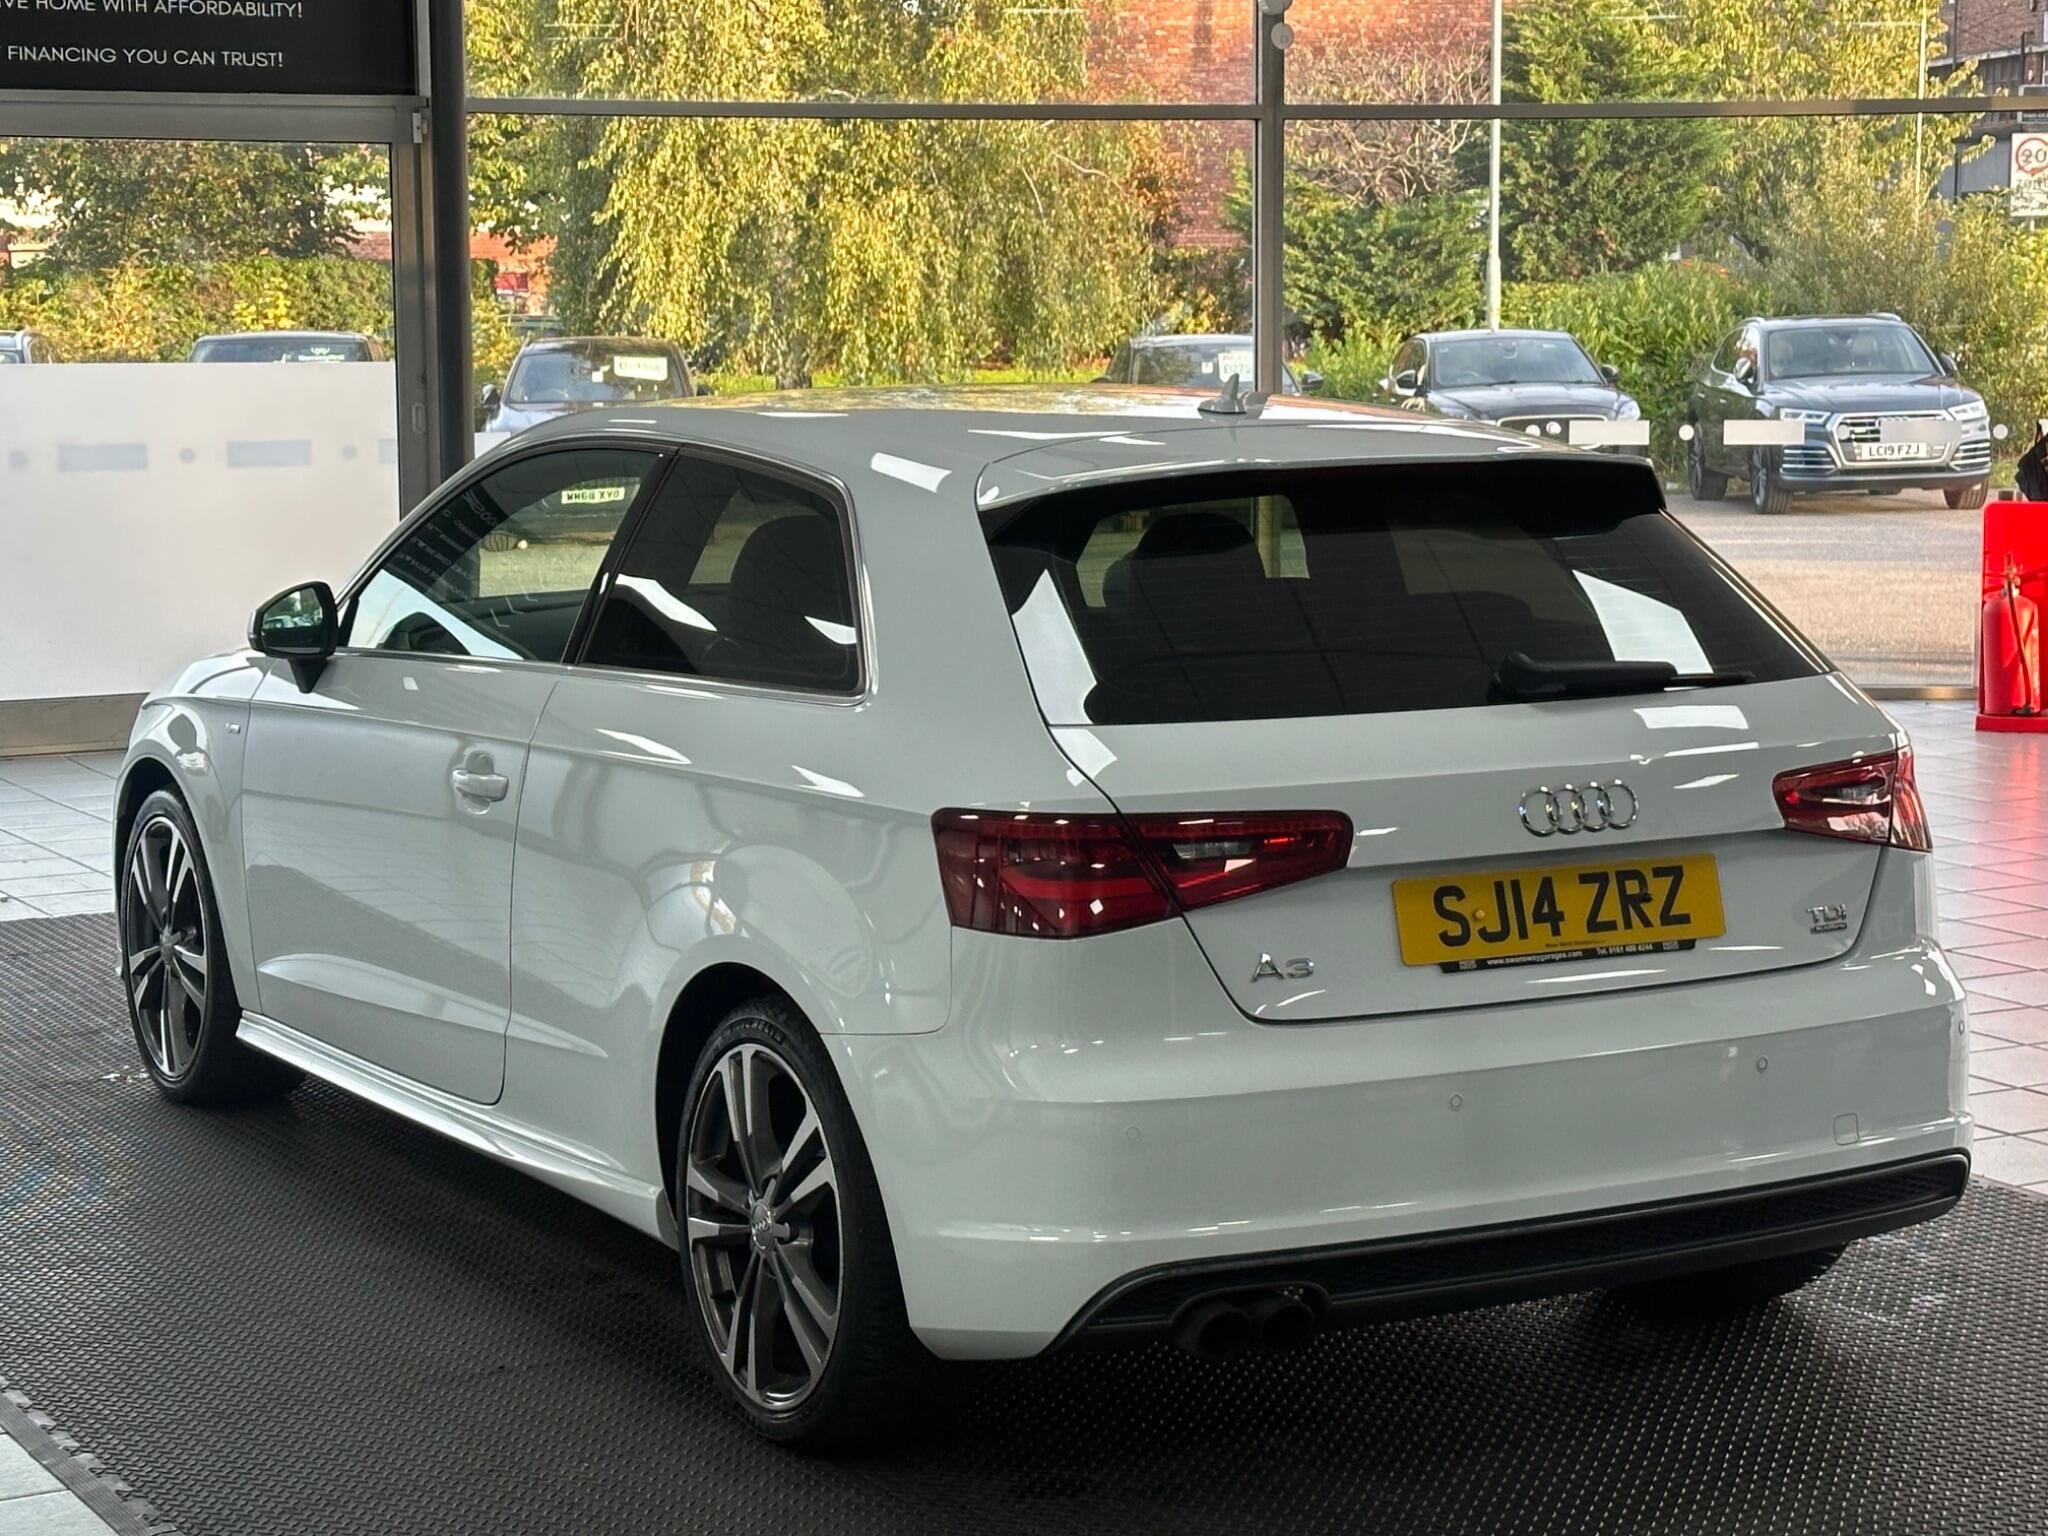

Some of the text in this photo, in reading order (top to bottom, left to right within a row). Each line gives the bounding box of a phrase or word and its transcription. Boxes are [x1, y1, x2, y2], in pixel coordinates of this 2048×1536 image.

[36, 0, 96, 11] HOME
[103, 0, 147, 13] WITH
[153, 0, 302, 18] AFFORDABILITY!
[7, 45, 283, 67] FINANCING YOU CAN TRUST!
[2022, 148, 2047, 165] 20
[1869, 443, 1920, 457] LC19 FZJ
[1433, 865, 1692, 947] SJ14 ZRZ
[1806, 904, 1847, 923] TDI
[1249, 953, 1314, 984] A3
